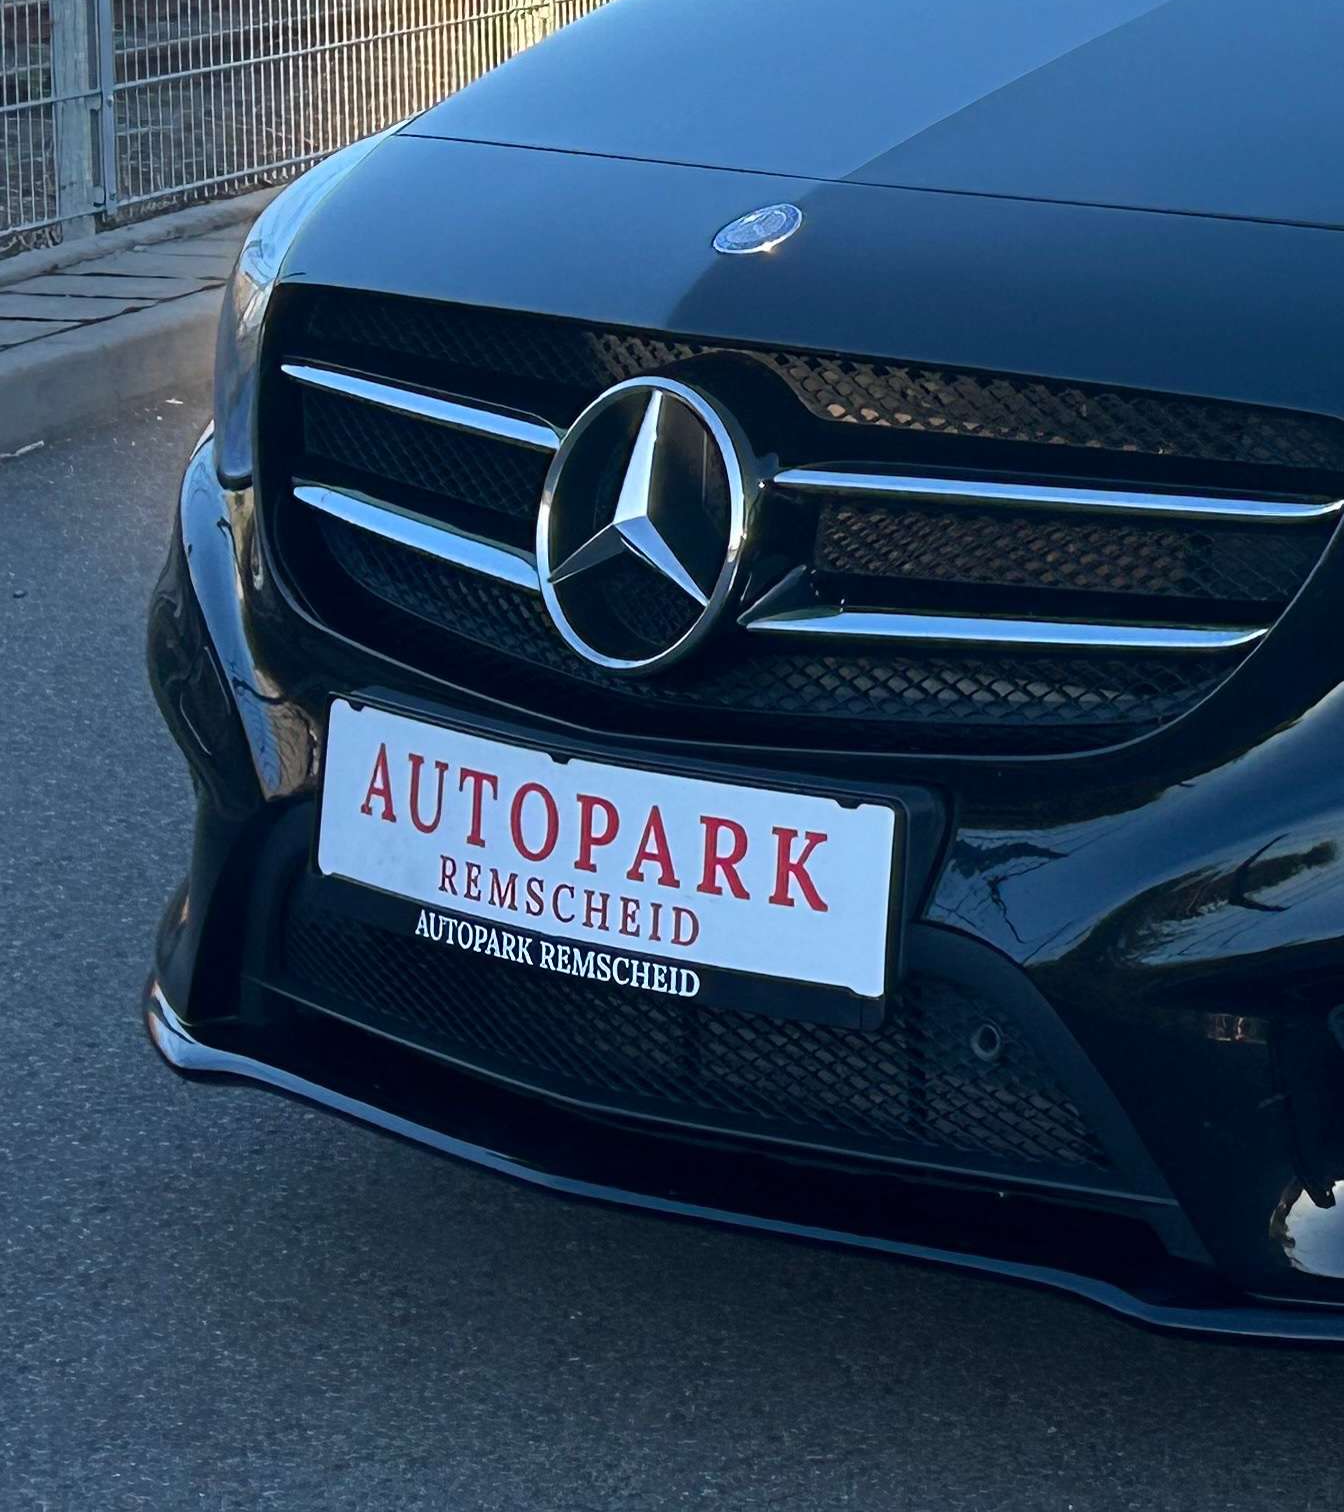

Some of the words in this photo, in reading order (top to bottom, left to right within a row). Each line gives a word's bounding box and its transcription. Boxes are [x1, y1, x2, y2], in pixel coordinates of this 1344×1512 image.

[361, 743, 828, 912] AUTOPARK
[438, 855, 700, 946] REMSCHEID
[415, 909, 533, 966] AUTOPARK
[539, 942, 700, 997] REMSCHEID
